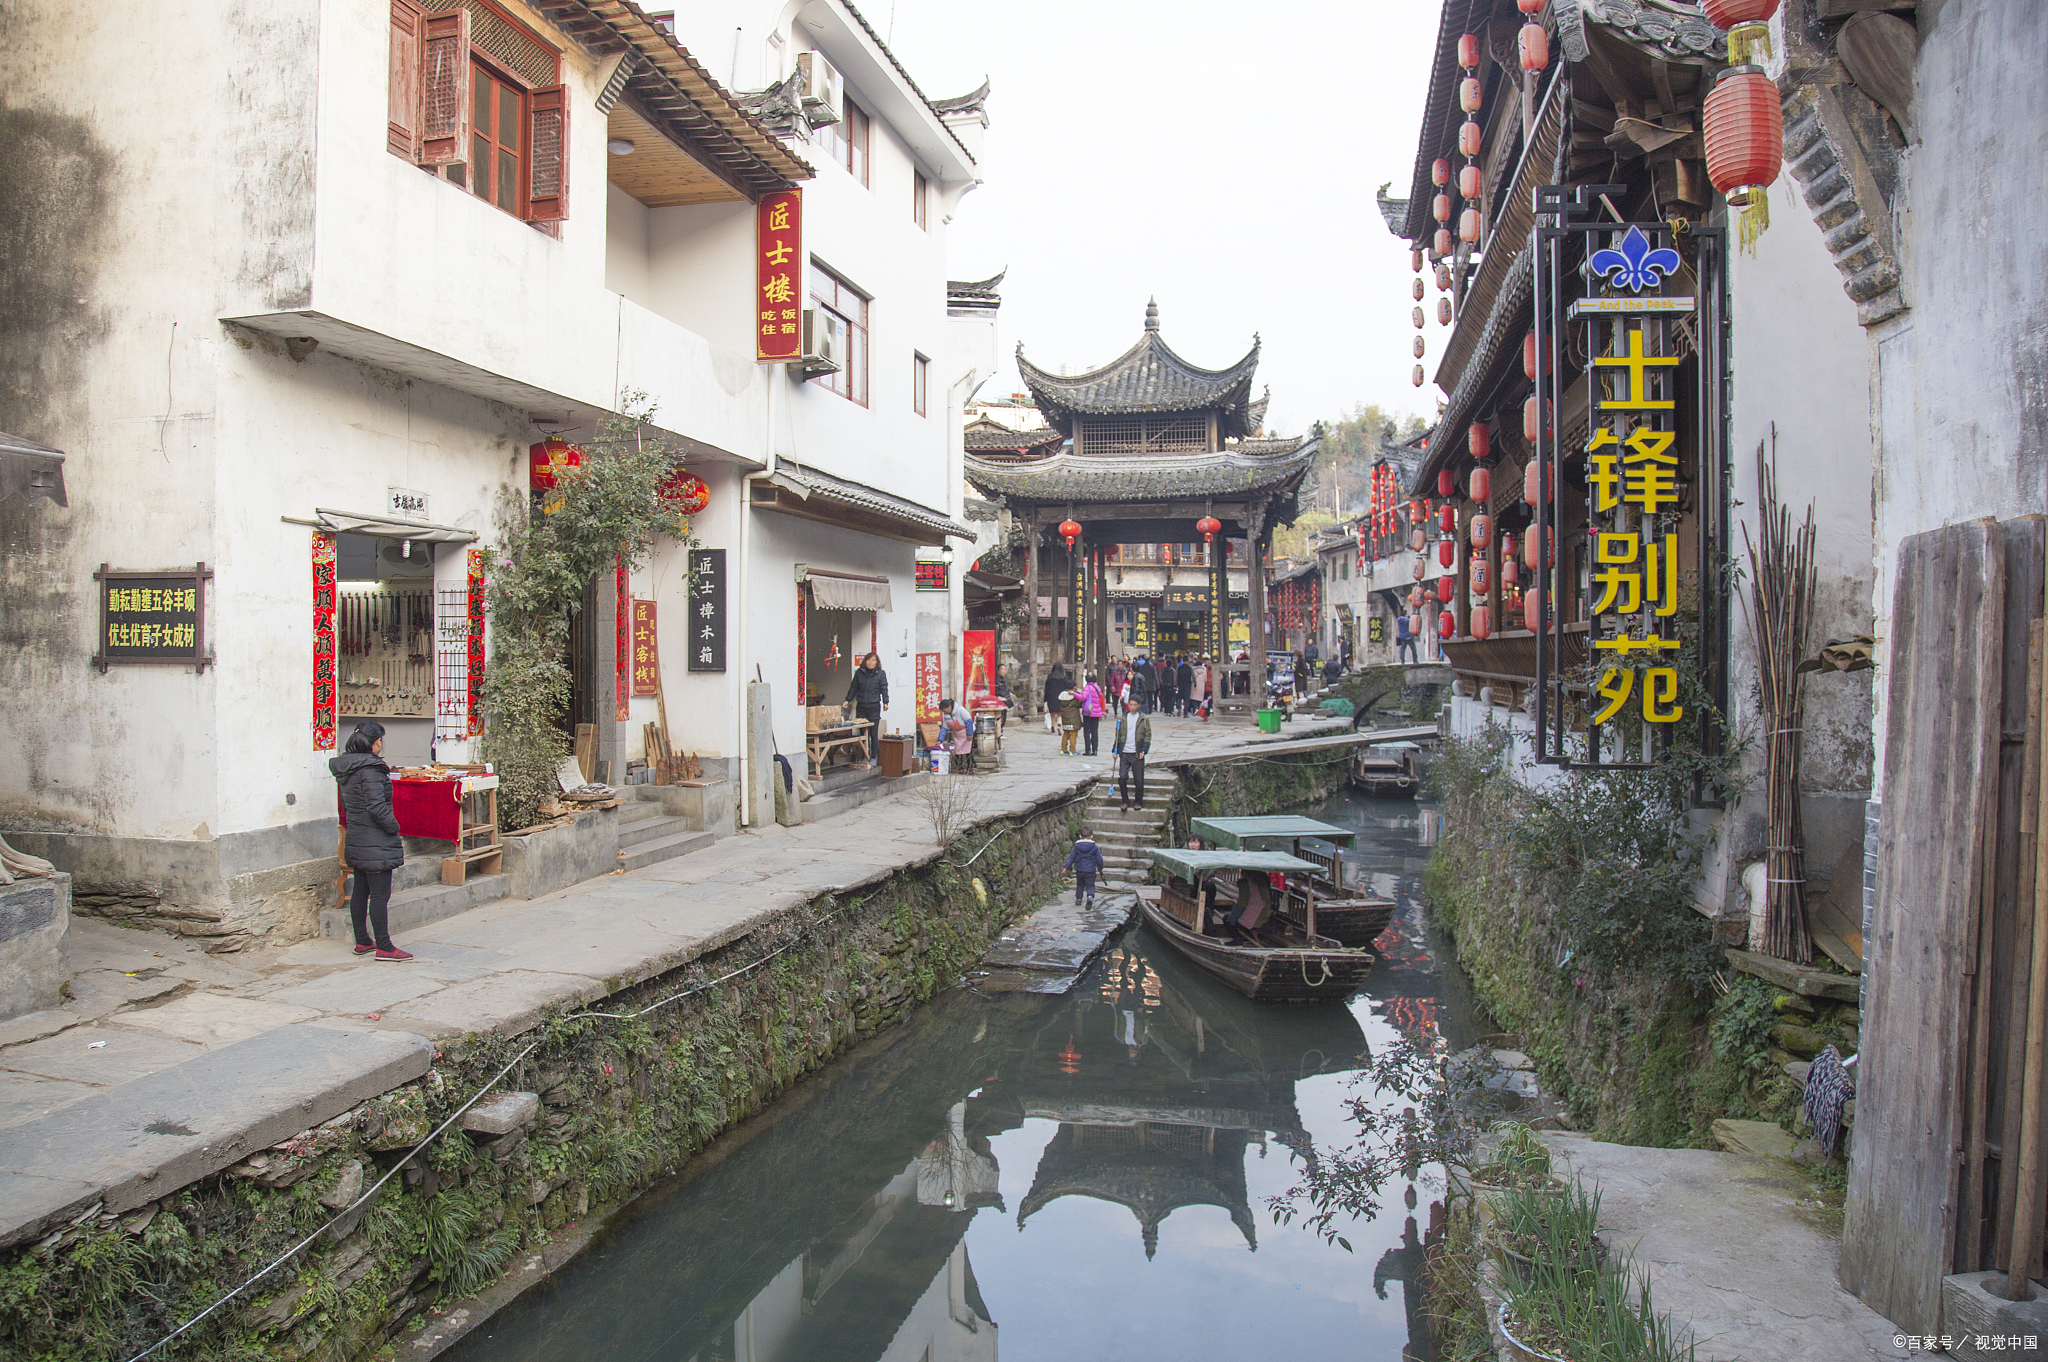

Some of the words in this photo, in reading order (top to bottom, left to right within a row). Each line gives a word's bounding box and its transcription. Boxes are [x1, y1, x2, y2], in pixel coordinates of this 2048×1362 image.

[763, 201, 796, 304] 匠士楼
[1599, 300, 1621, 310] And
[1624, 299, 1644, 310] the
[1475, 523, 1485, 540] 酒
[1594, 329, 1683, 725] 士锋别苑
[1474, 566, 1486, 585] 酒
[108, 622, 196, 648] 优生优育子女成材
[699, 557, 715, 664] 匠士樟木箱
[635, 605, 650, 684] 匠士客栈
